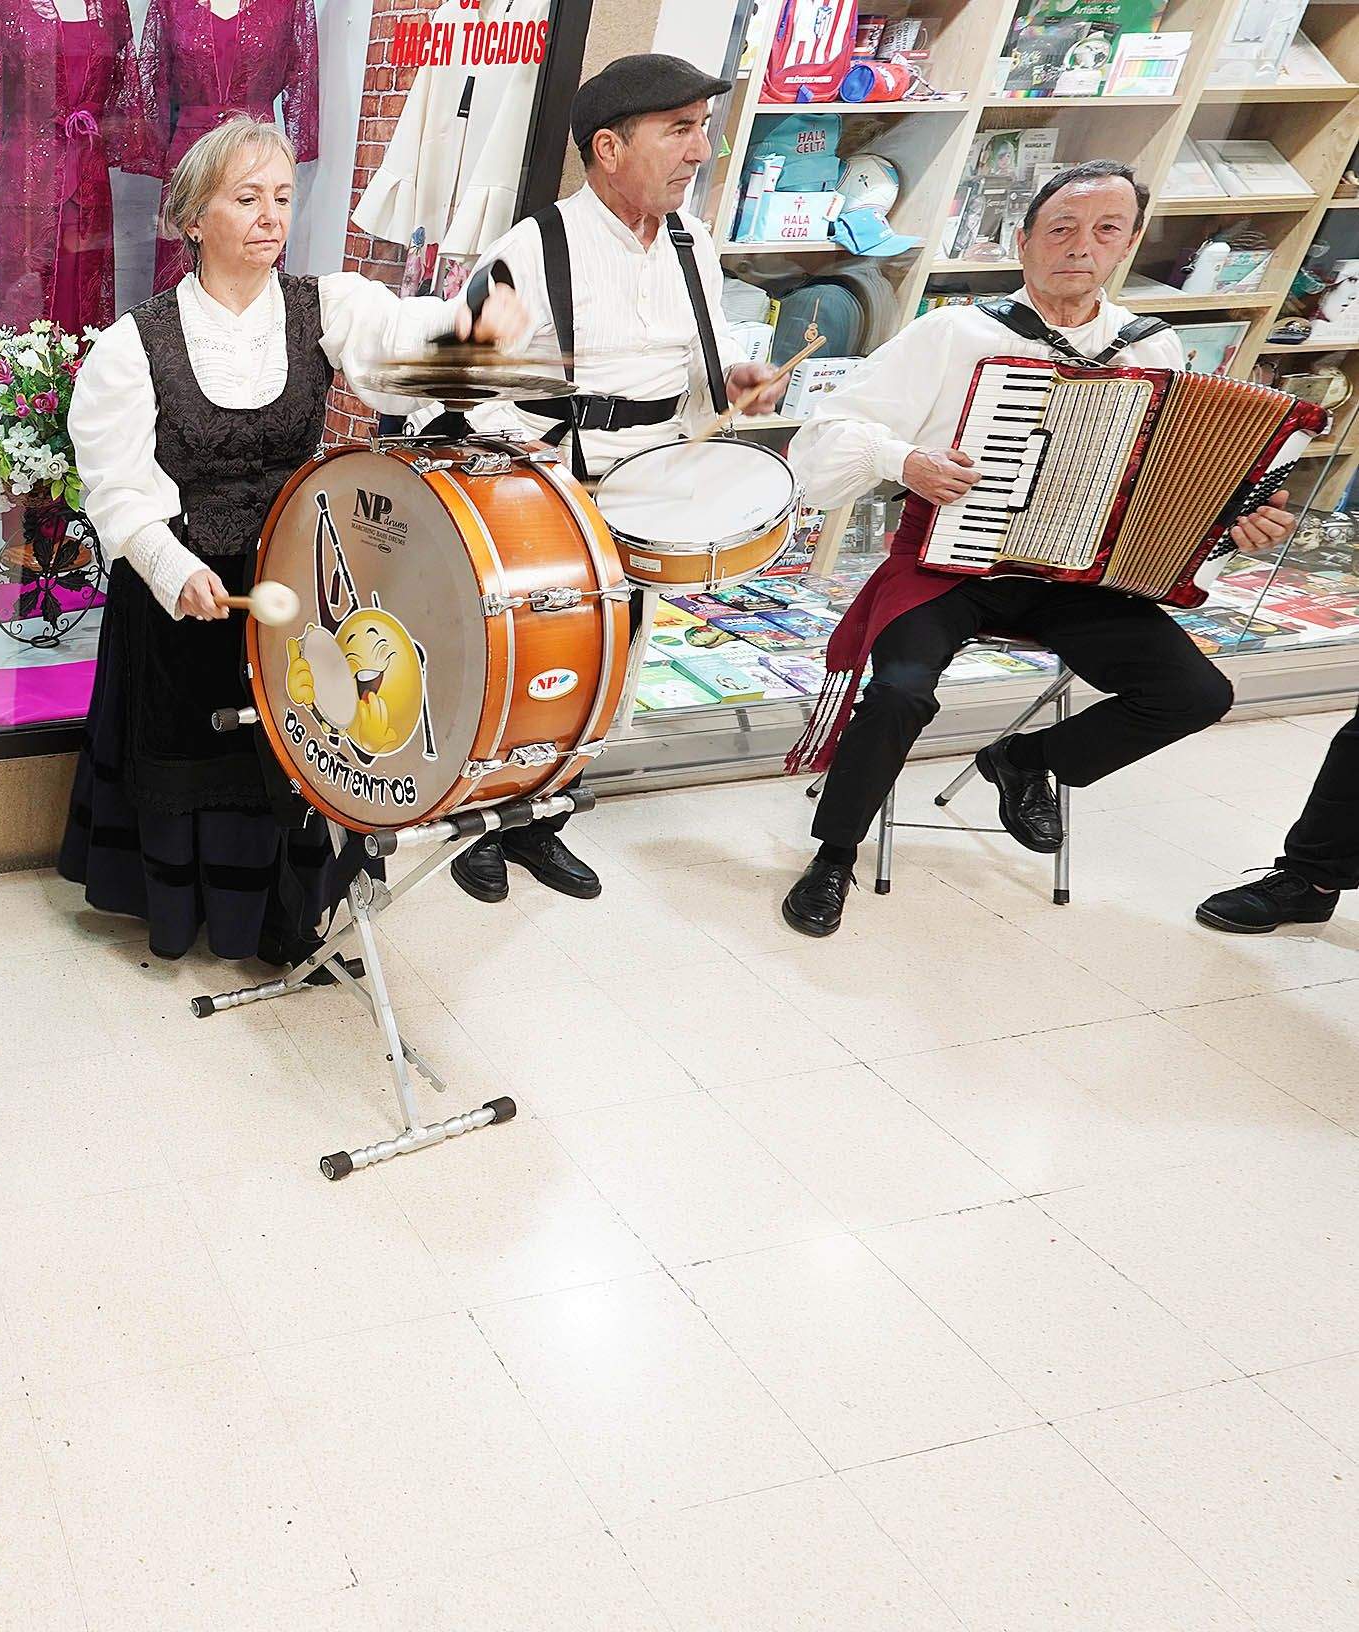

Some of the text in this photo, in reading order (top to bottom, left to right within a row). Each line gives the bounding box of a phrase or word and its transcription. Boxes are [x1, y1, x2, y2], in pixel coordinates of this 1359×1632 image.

[1073, 5, 1121, 15] Artistic Set
[392, 20, 550, 66] HACEN TOCADOS
[798, 130, 826, 143] HALA
[796, 142, 826, 153] CELTA
[783, 215, 810, 225] HALA
[781, 227, 809, 238] CELTA
[353, 487, 393, 525] NP
[383, 515, 408, 533] drums
[536, 675, 558, 691] NP
[284, 708, 417, 806] OS CONTENTOS
